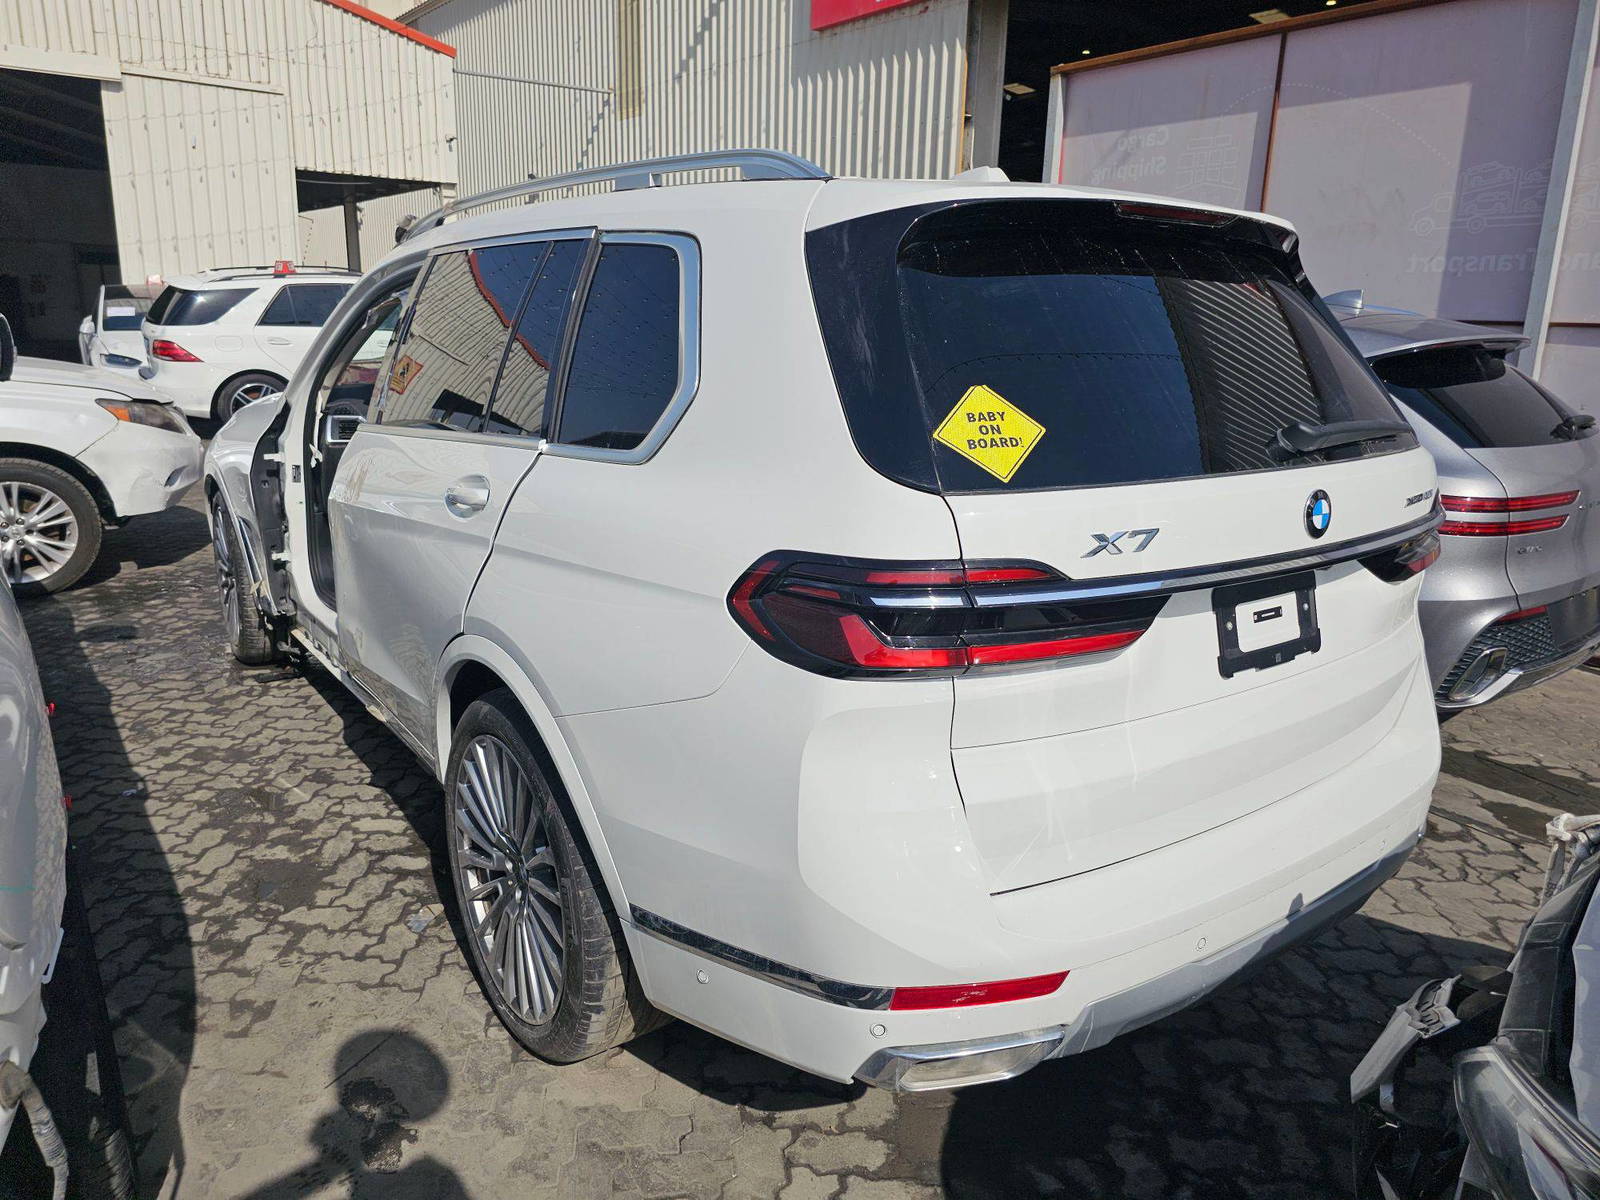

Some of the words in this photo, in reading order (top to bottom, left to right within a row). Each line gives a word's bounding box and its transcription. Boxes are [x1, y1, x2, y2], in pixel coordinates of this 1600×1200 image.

[966, 411, 1006, 423] BABY
[978, 424, 1002, 436] ON
[966, 437, 1025, 450] BOARD!
[1080, 527, 1160, 559] X7
